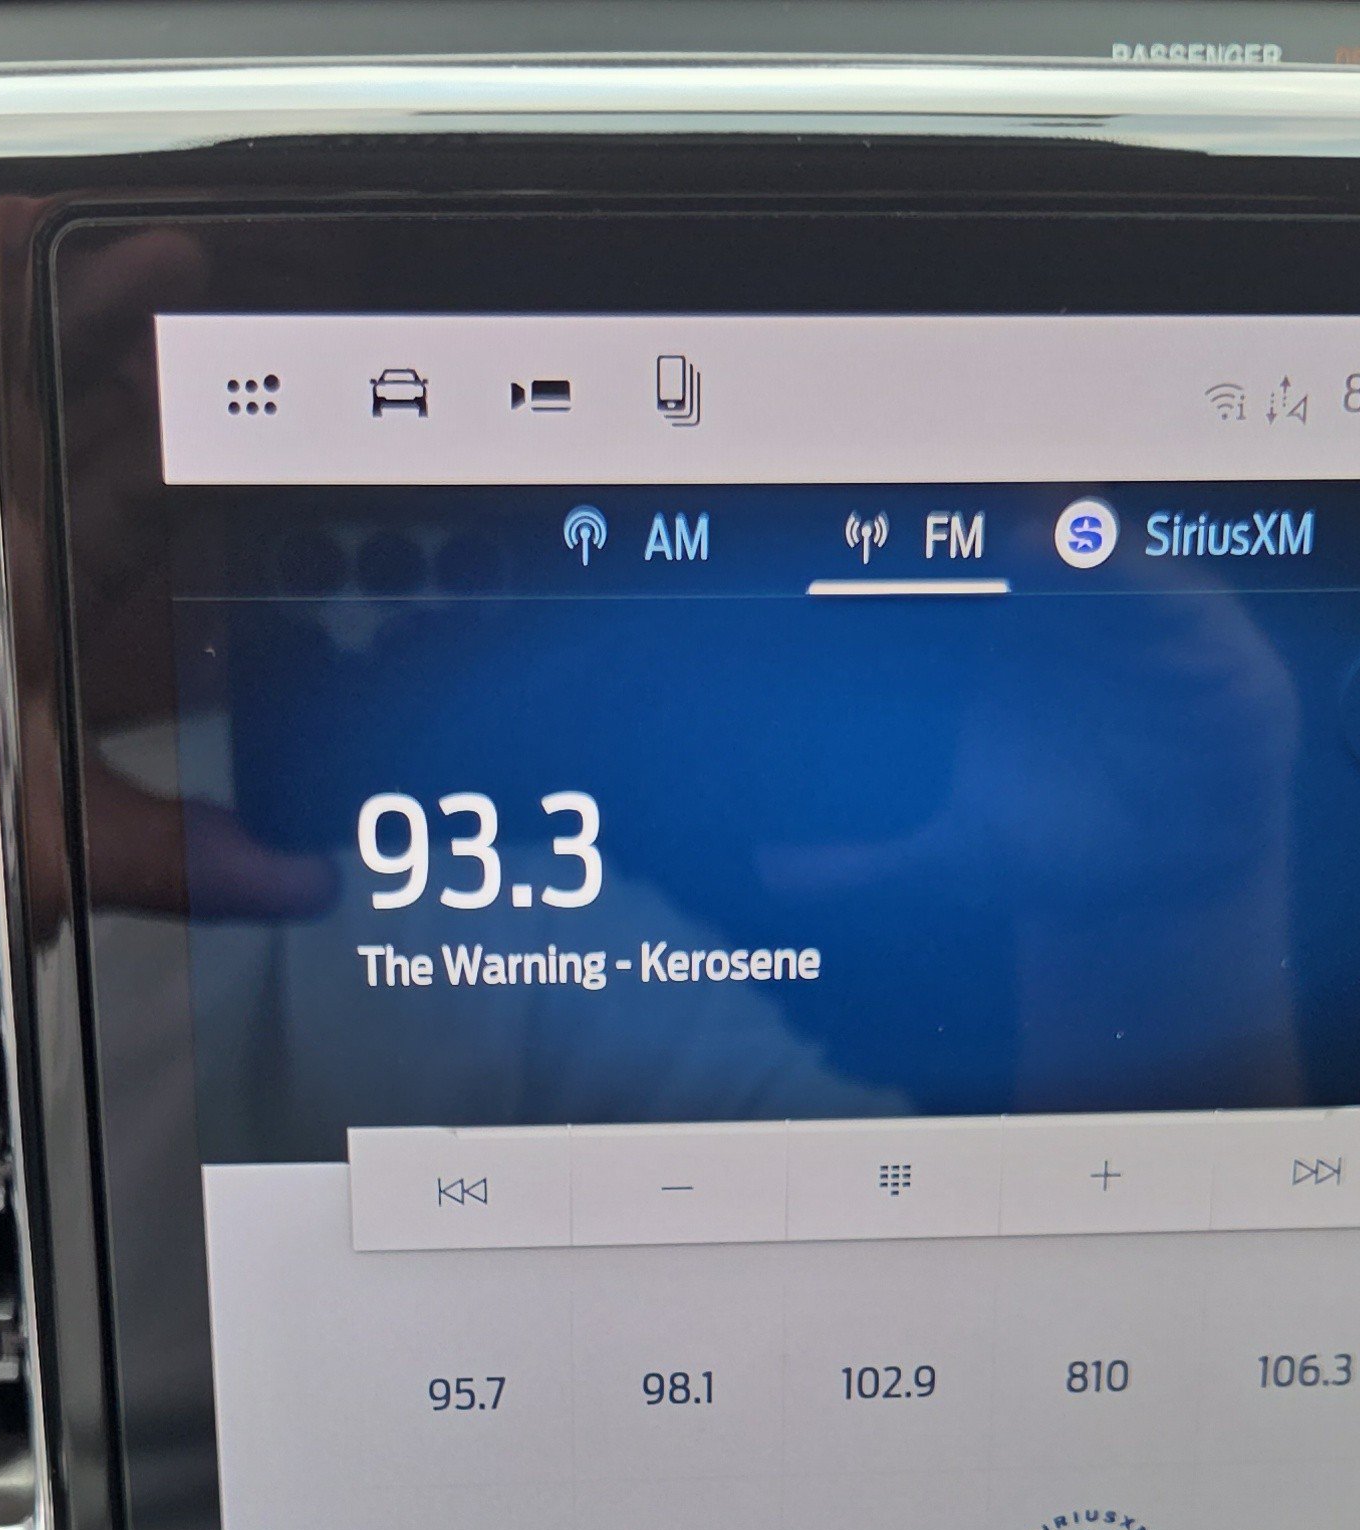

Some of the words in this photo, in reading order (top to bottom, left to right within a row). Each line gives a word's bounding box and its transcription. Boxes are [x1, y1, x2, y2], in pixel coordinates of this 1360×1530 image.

[1111, 43, 1283, 65] PASSENGER
[644, 512, 710, 562] AM
[925, 511, 986, 560] FM
[1145, 510, 1315, 558] SiriusXM
[357, 790, 603, 910] 93.3
[356, 943, 434, 987] The
[441, 943, 608, 990] Warning
[641, 941, 821, 983] Kerosene
[642, 1370, 714, 1406] 98.1
[841, 1365, 937, 1400] 102.9
[1066, 1359, 1130, 1394] 810
[1257, 1353, 1353, 1389] 106.3
[428, 1376, 507, 1412] 95.7
